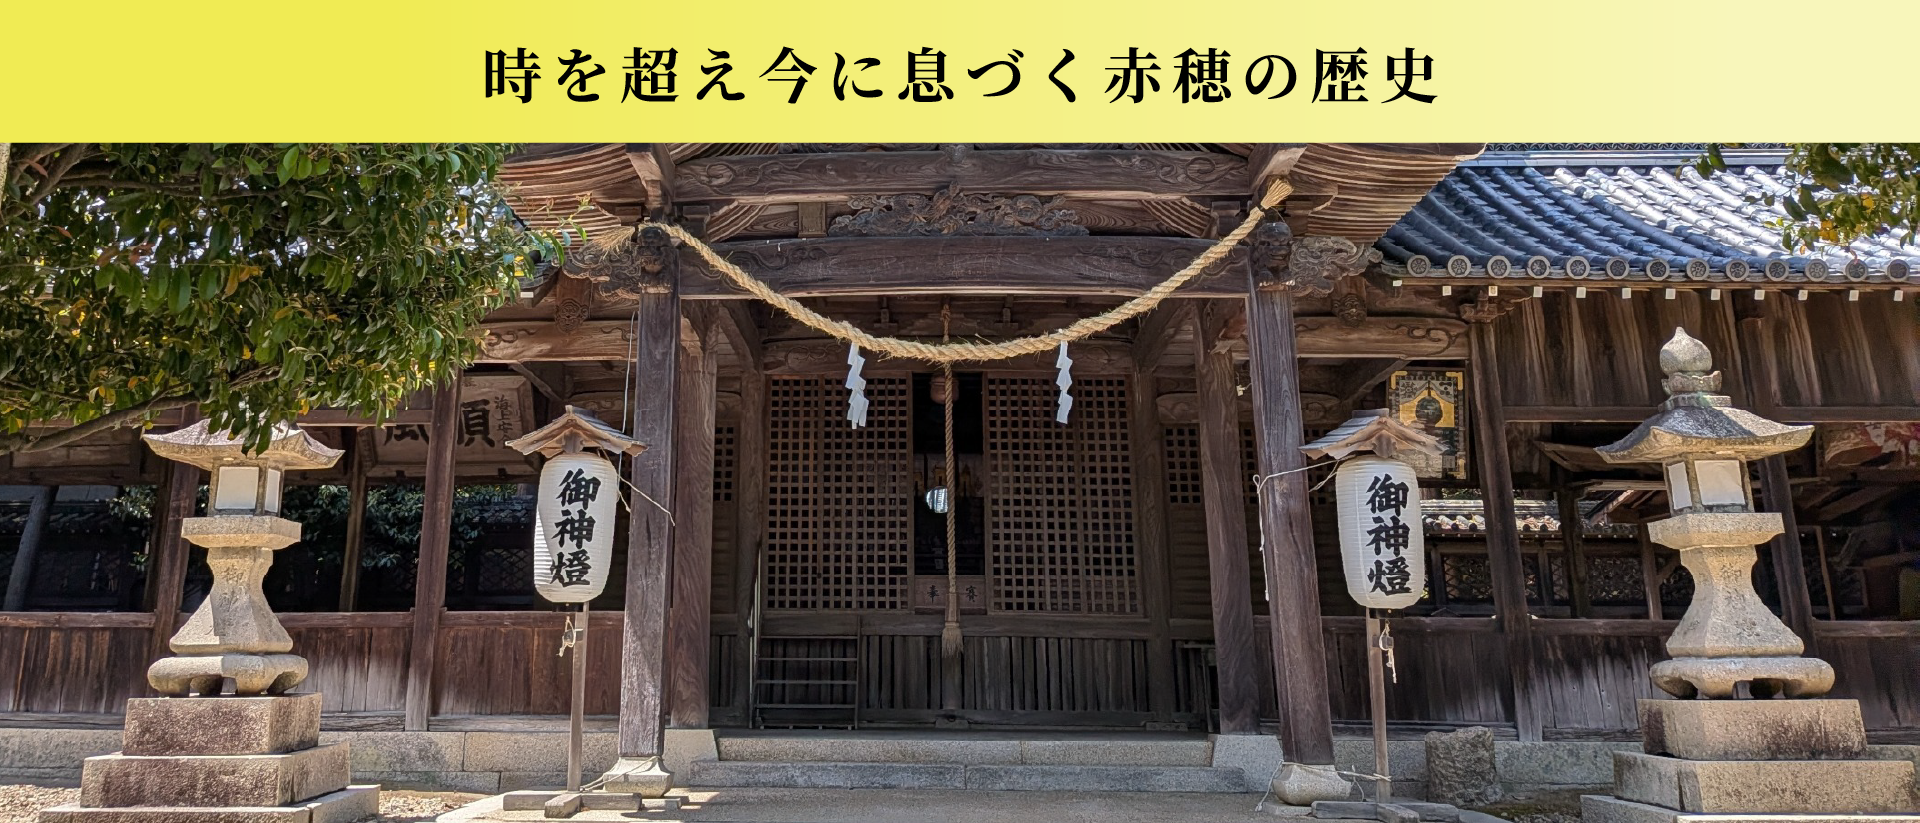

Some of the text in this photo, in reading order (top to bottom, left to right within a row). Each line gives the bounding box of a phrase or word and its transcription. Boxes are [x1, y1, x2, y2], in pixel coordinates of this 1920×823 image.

[550, 467, 602, 588] 御神燈
[1366, 473, 1413, 597] 御神燈
